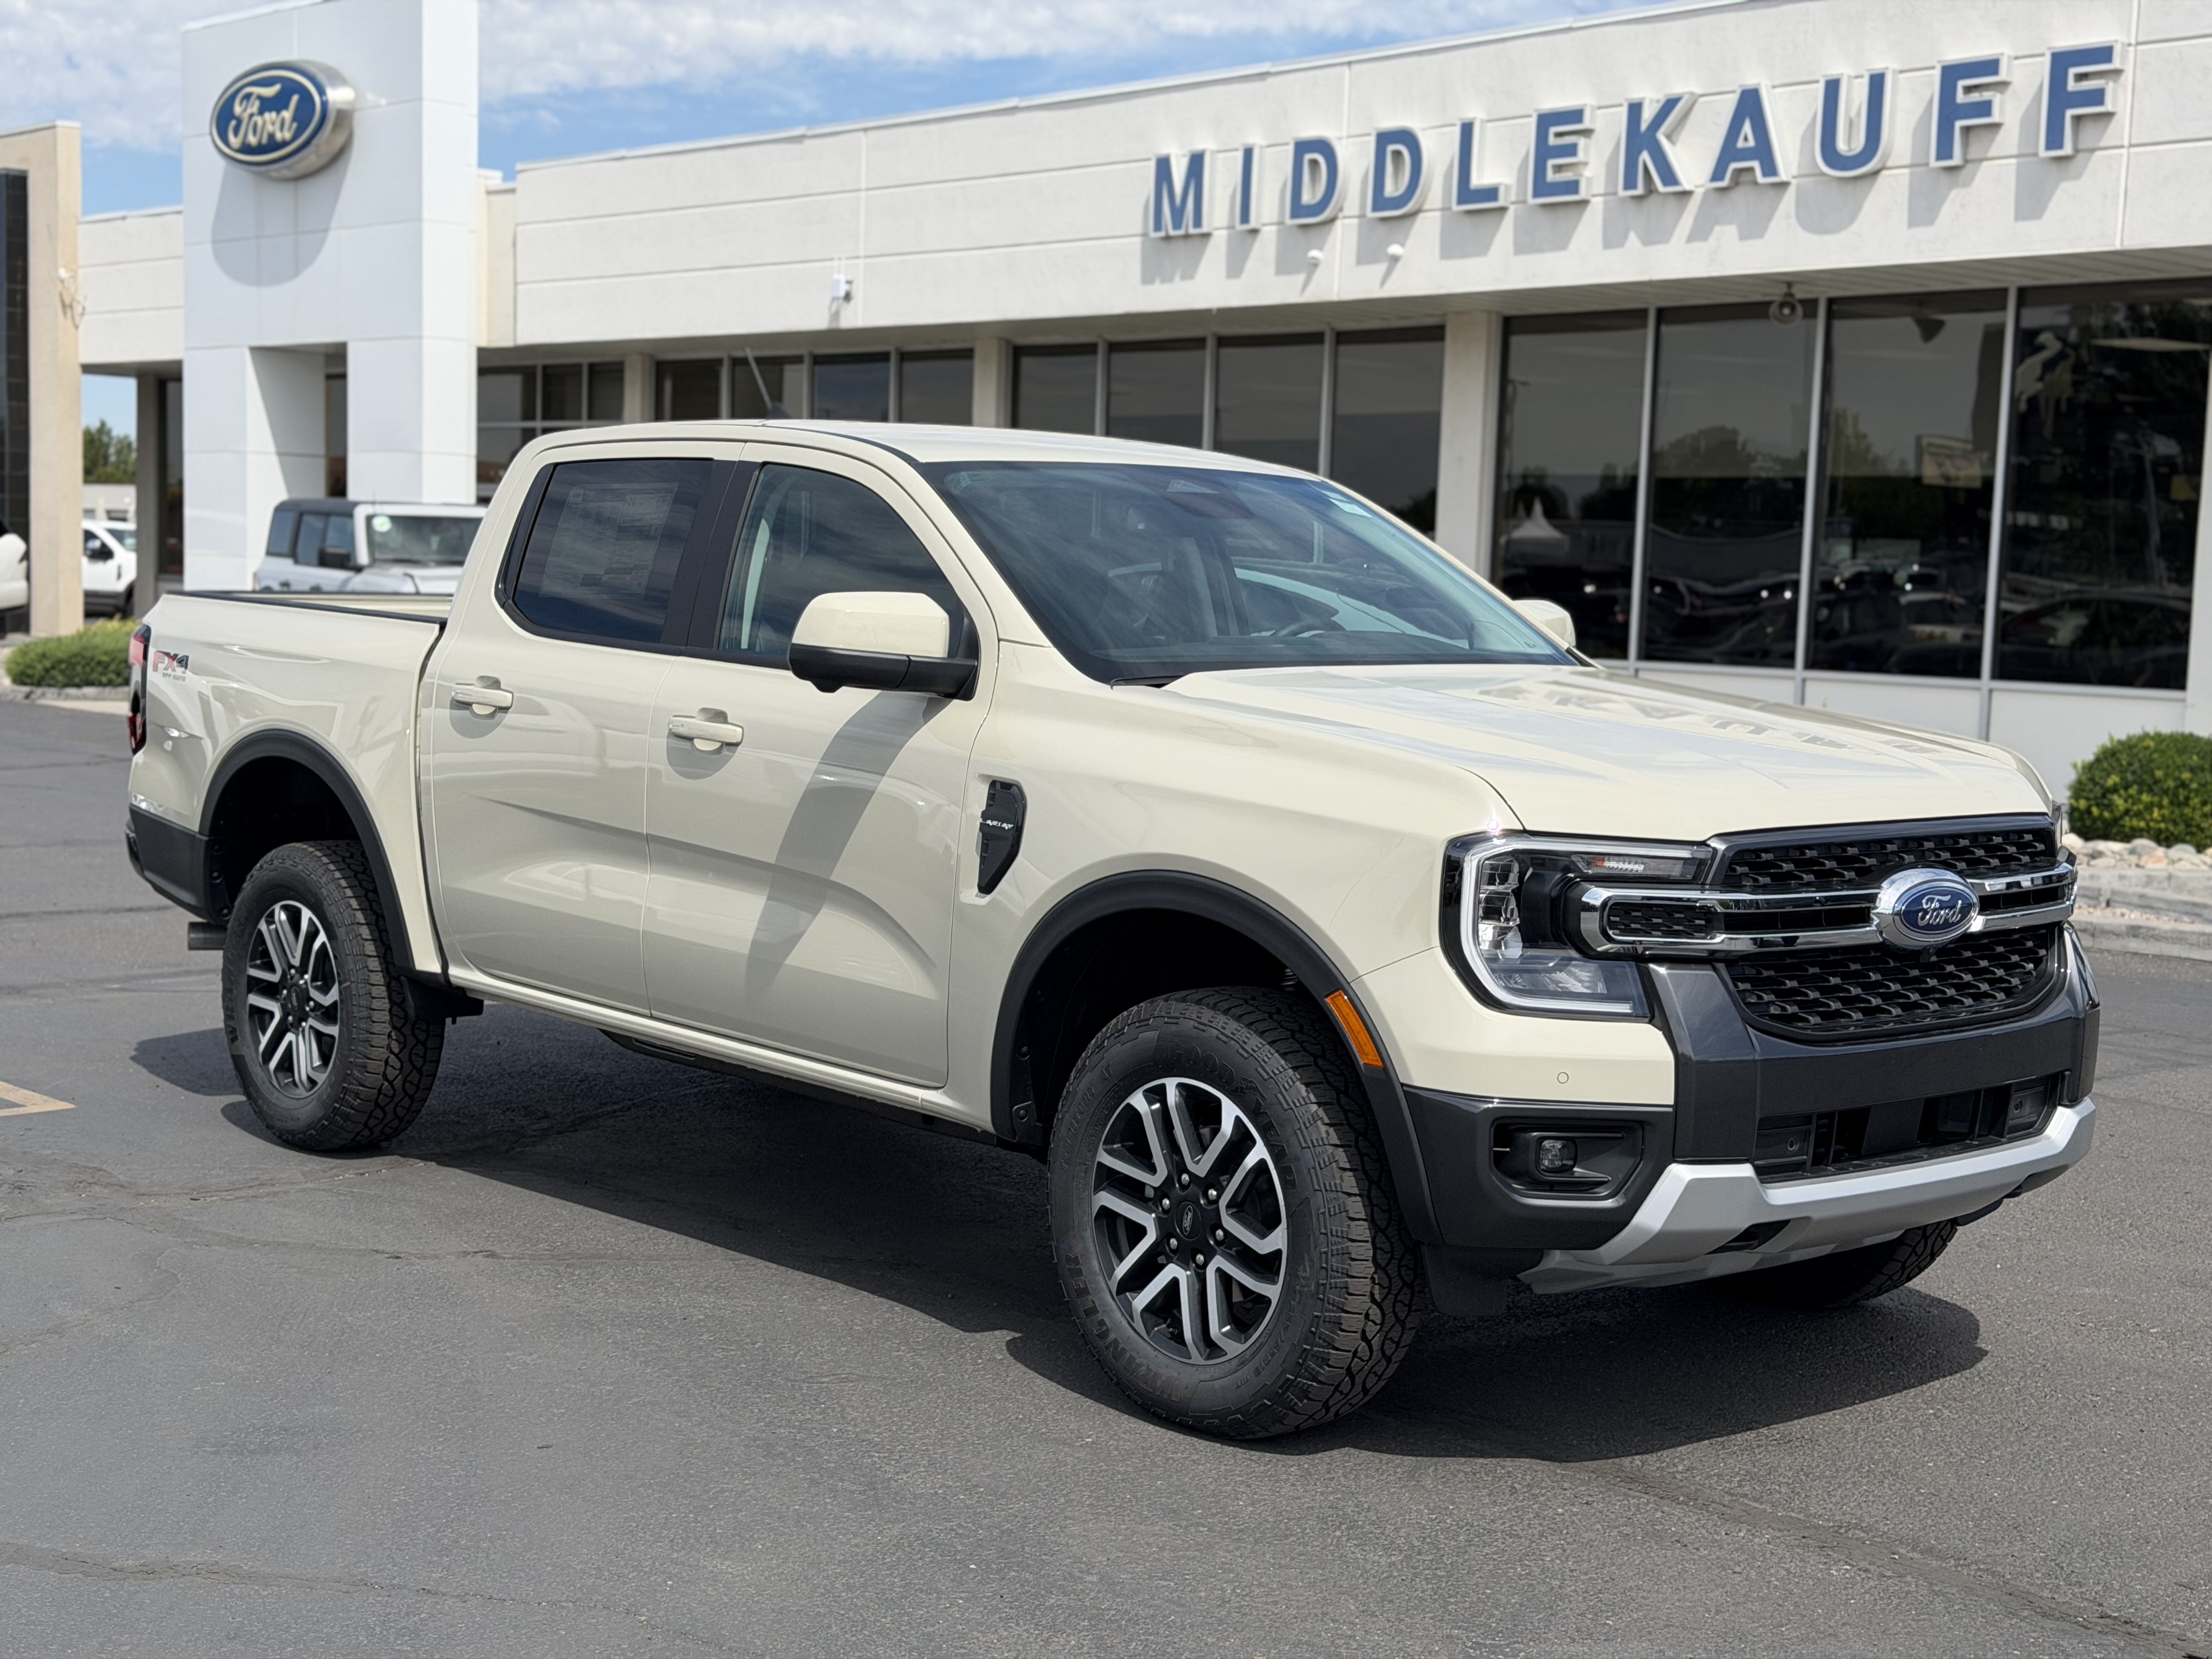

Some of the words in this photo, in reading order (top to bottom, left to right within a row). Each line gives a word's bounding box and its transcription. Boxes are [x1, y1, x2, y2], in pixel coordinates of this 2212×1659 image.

[227, 82, 300, 150] Ford
[1151, 43, 2121, 236] MIDDLEKAUFF
[153, 650, 190, 673] FX4
[1917, 894, 1962, 927] Ford
[1064, 1251, 1182, 1403] WRANGLER
